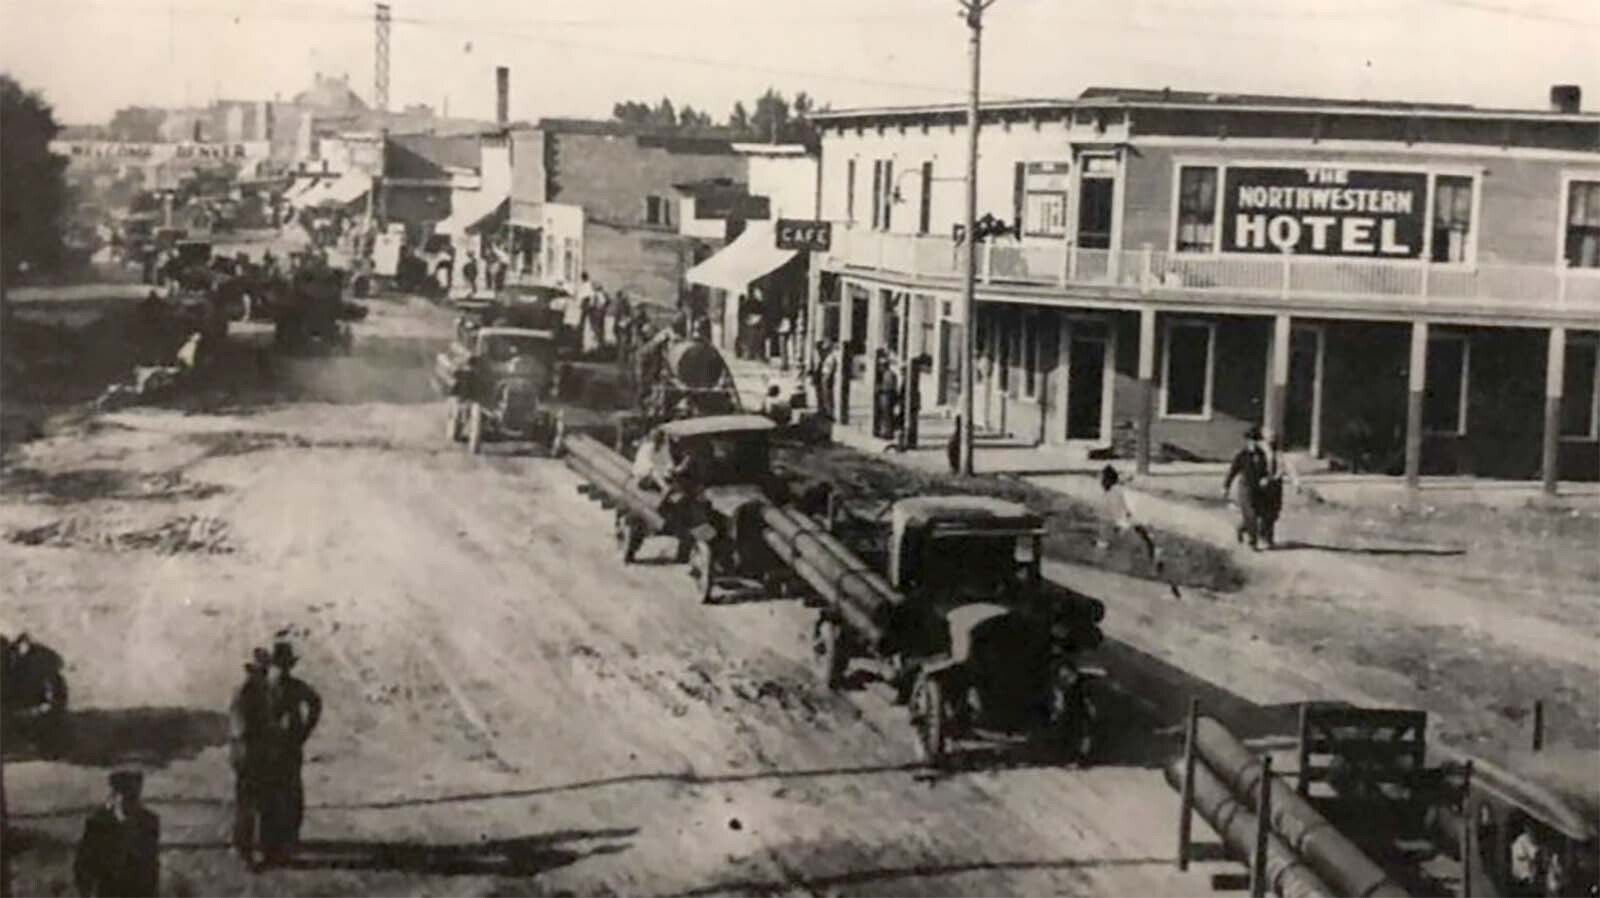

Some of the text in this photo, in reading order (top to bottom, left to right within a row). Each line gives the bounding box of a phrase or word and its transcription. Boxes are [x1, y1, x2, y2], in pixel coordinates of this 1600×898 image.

[1306, 168, 1348, 184] THE
[1239, 186, 1412, 214] NORTHWESTERN
[782, 226, 828, 245] CAFE
[1236, 214, 1410, 254] HOTEL
